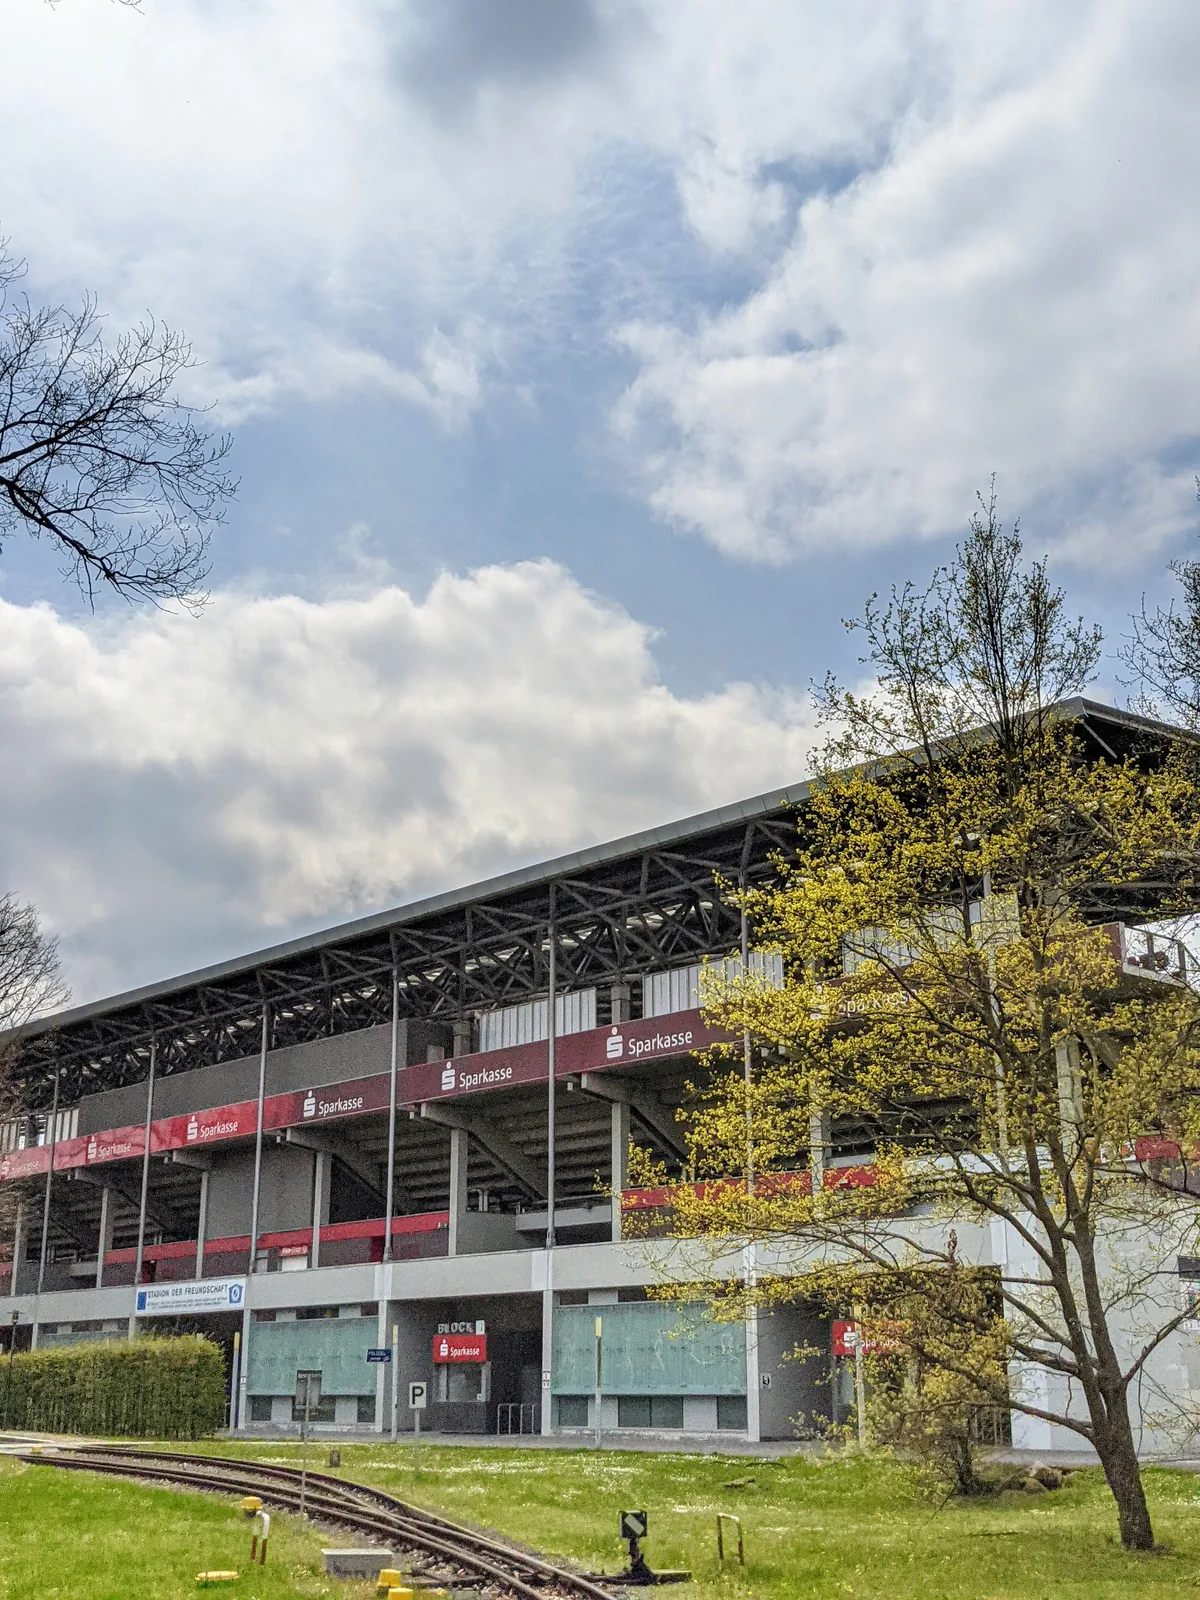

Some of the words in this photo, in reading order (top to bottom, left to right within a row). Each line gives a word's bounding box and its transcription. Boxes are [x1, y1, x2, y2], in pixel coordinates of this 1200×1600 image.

[628, 1029, 693, 1056] Sparkasse
[459, 1065, 512, 1090] Sparkasse
[318, 1096, 363, 1117] Sparkasse
[199, 1120, 239, 1138] Sparkasse
[98, 1142, 132, 1158] Sparkasse
[148, 1290, 169, 1298] STADION
[171, 1288, 183, 1296] DER
[184, 1284, 228, 1295] FREUNDSCHAFT
[437, 1321, 474, 1333] BLOCK
[450, 1346, 480, 1358] Sparkasse
[411, 1385, 425, 1405] P
